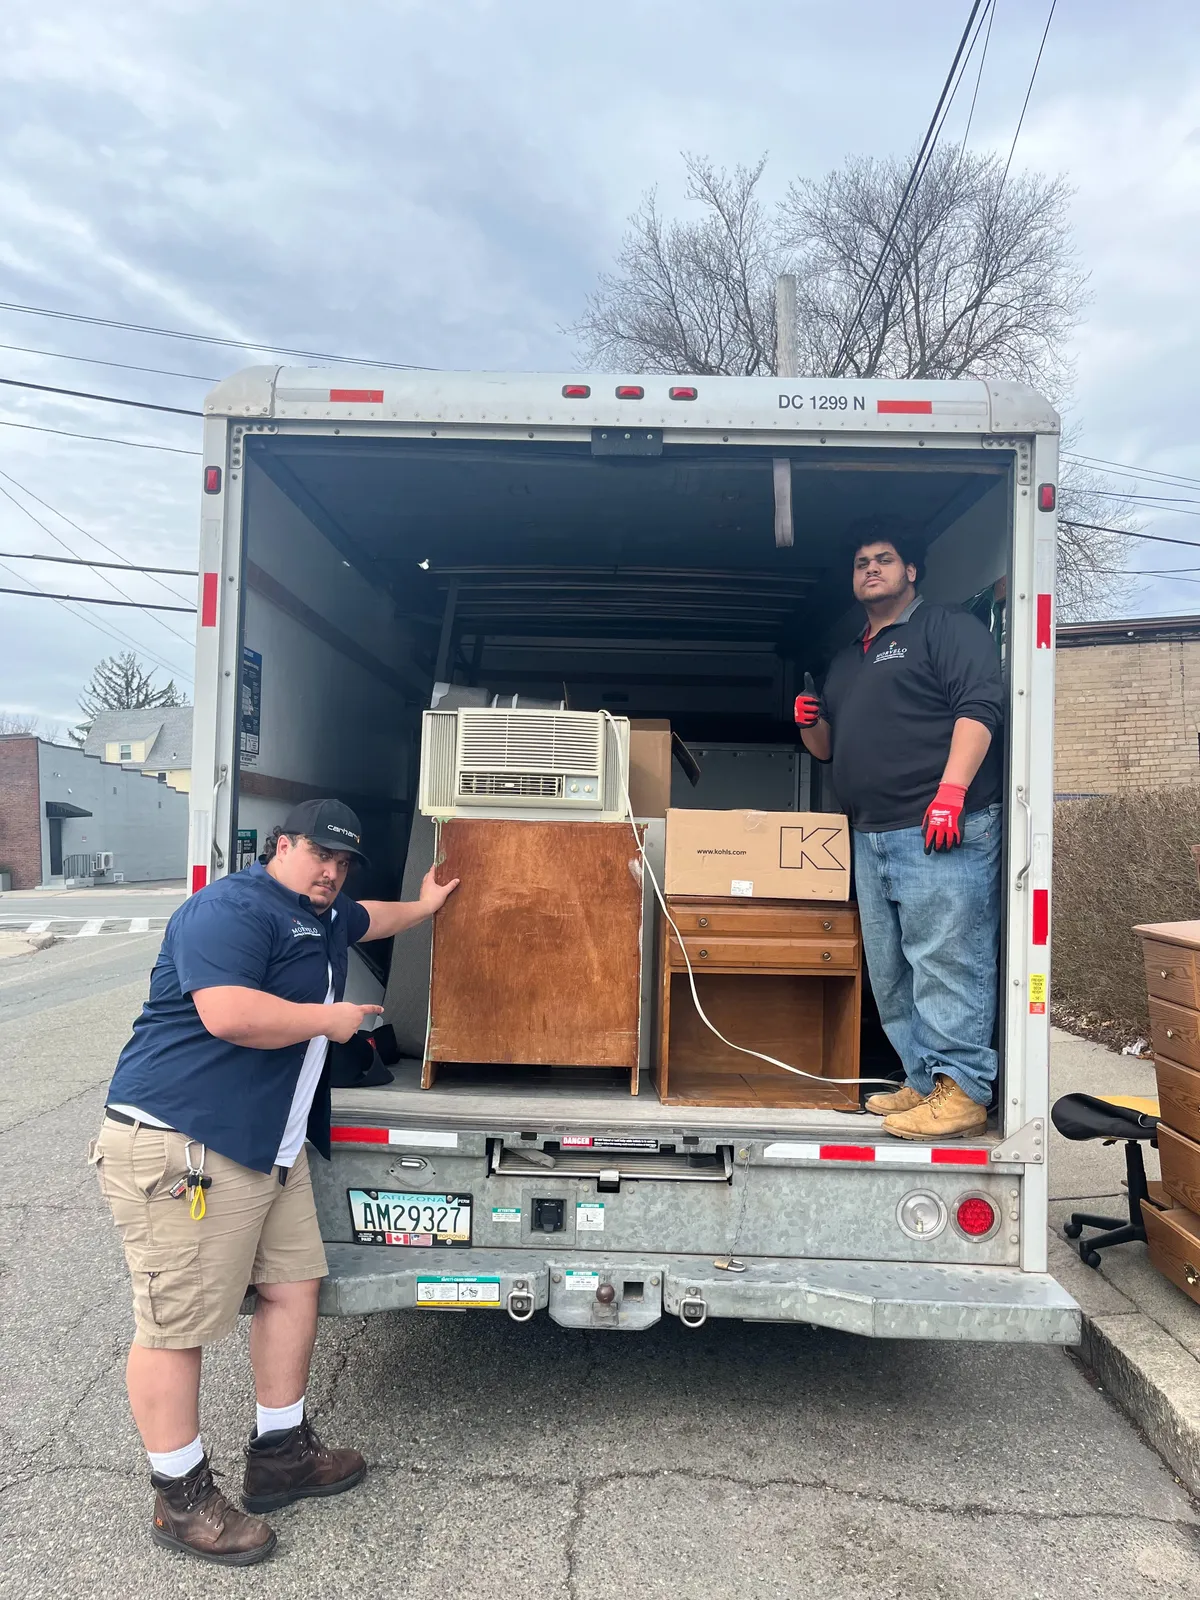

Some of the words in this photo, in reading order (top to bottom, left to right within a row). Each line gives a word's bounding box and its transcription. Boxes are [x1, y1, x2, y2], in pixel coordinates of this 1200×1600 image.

[778, 394, 804, 410] DC
[809, 395, 848, 410] 1299
[853, 396, 865, 410] N
[696, 848, 747, 856] www.kohls.com
[779, 826, 846, 871] K
[562, 1136, 591, 1145] DANGER
[380, 1193, 446, 1203] ARIZONA
[363, 1201, 462, 1233] AM29327
